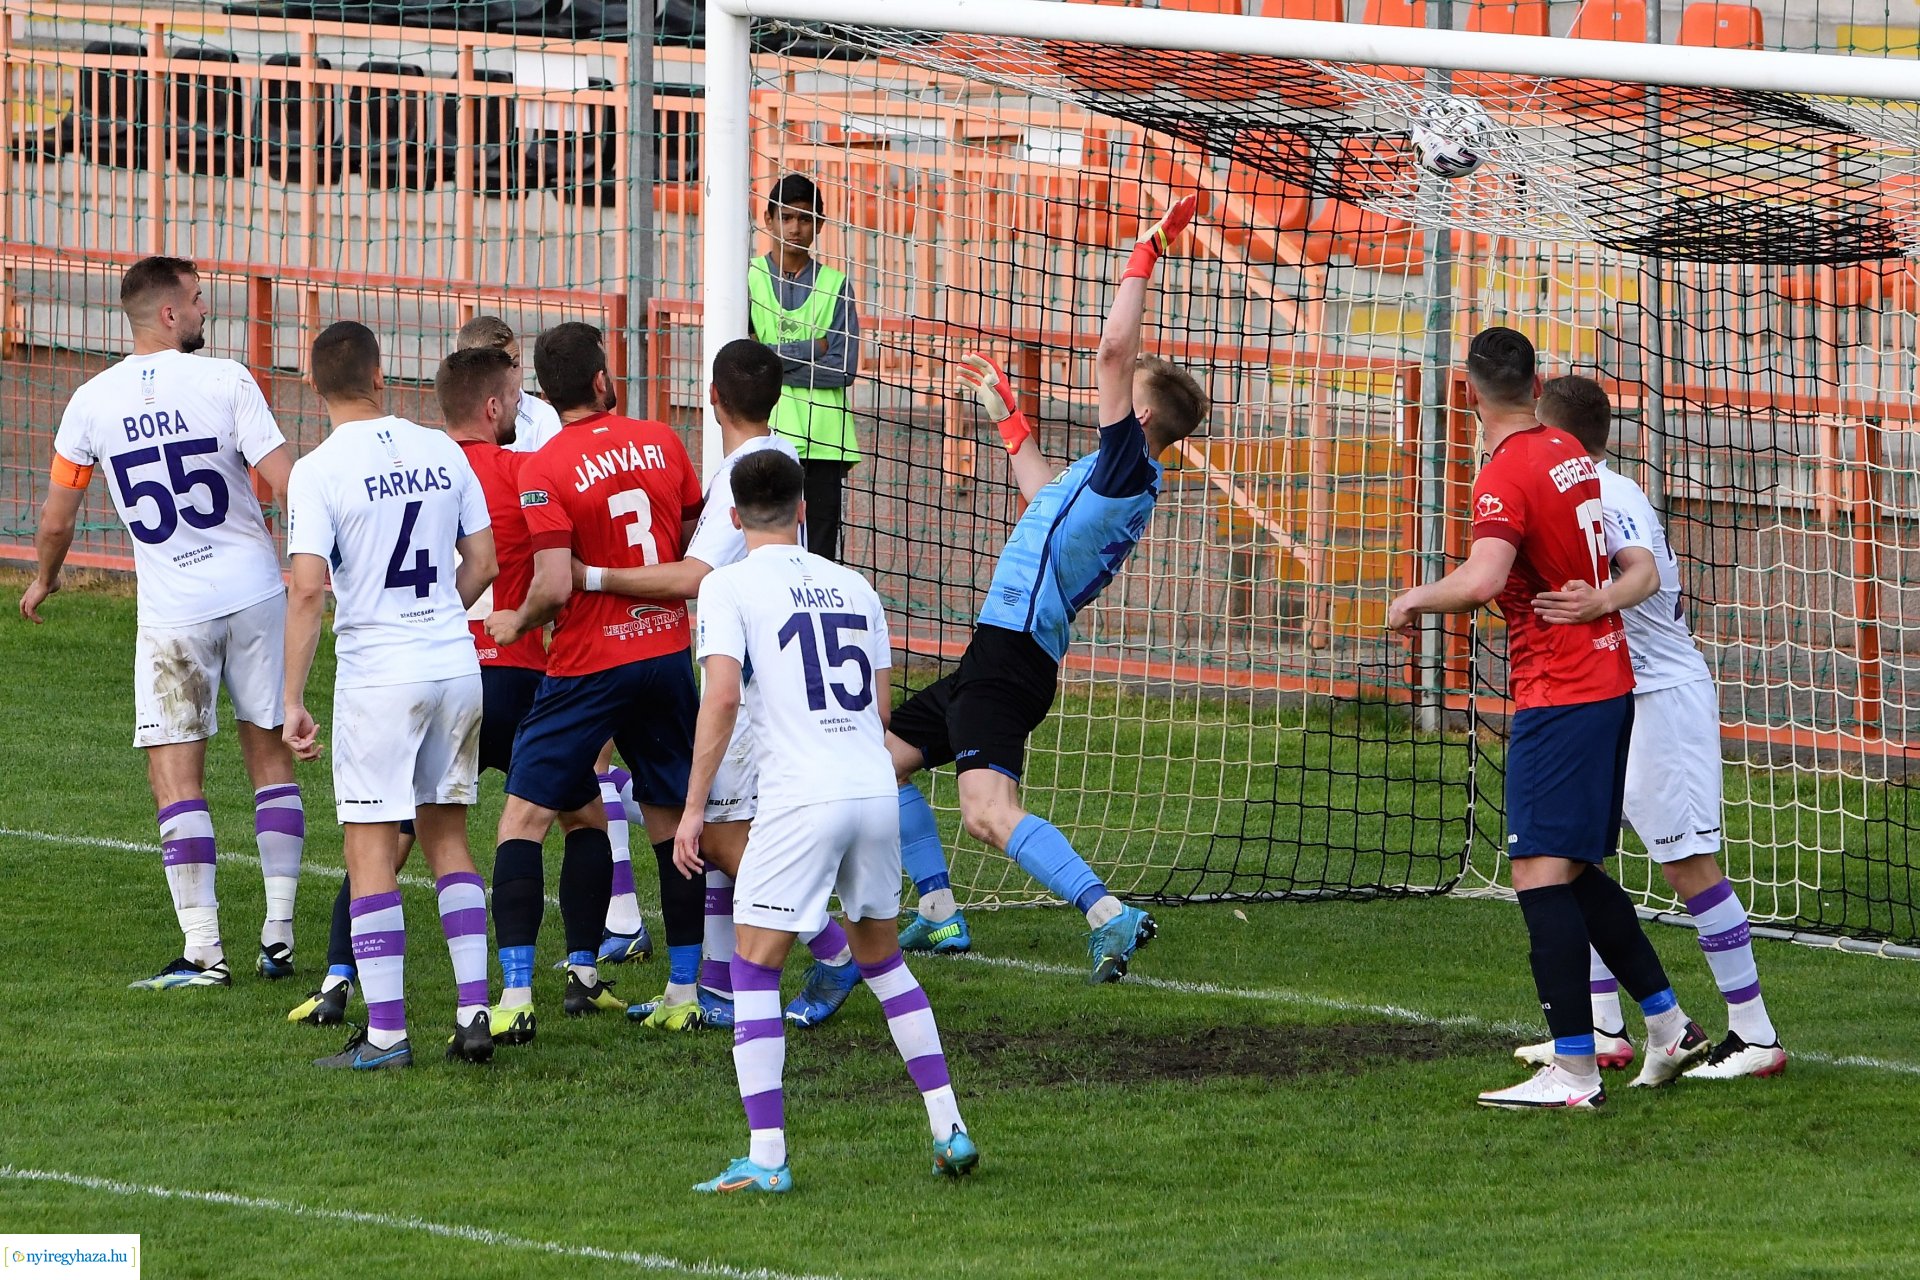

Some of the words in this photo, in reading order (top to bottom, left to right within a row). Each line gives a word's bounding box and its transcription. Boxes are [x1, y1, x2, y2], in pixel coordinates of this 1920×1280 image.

[123, 410, 189, 442] BORA
[110, 437, 229, 544] 55
[364, 466, 451, 501] FARKAS
[575, 441, 666, 492] JÁNVÁRI
[384, 500, 438, 599] 4
[608, 488, 659, 567] 3
[789, 582, 845, 608] MÁRIS
[777, 612, 873, 712] 15
[927, 923, 960, 945] PUMA
